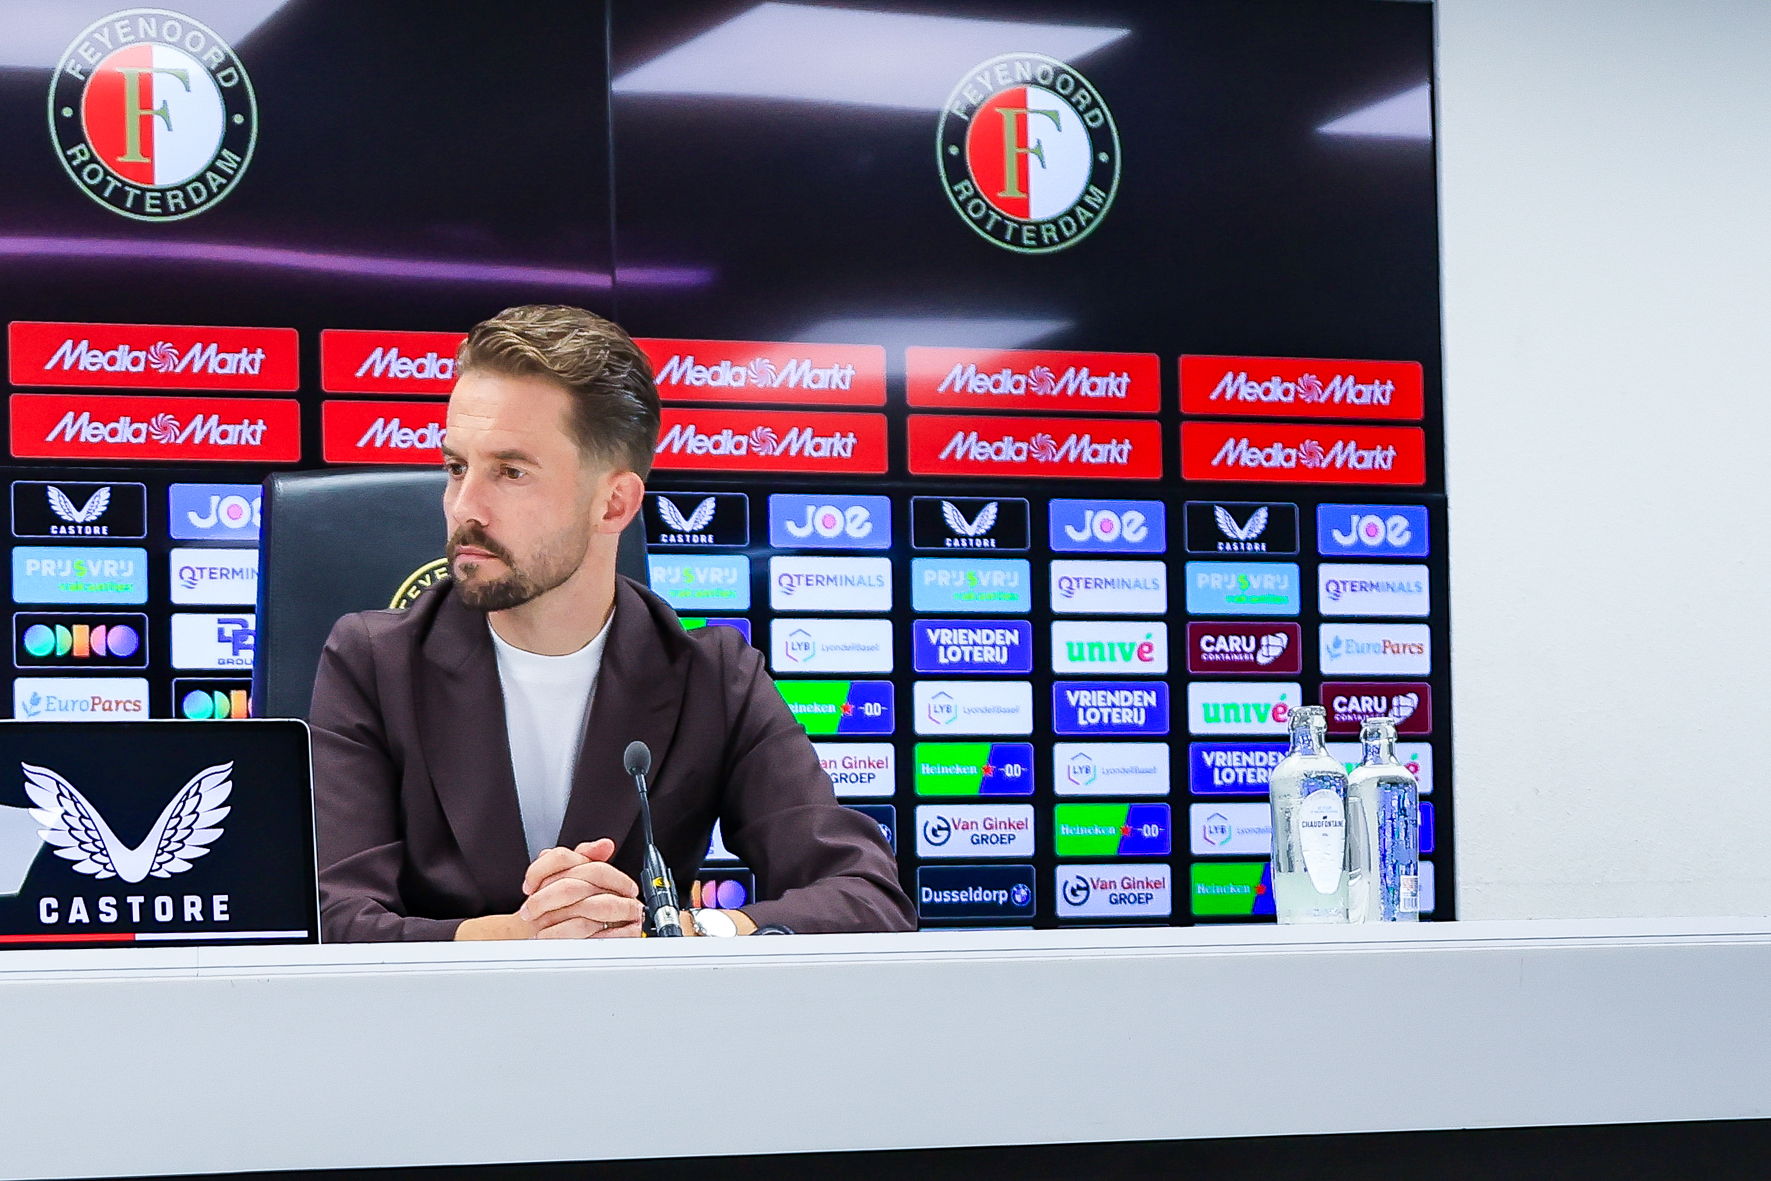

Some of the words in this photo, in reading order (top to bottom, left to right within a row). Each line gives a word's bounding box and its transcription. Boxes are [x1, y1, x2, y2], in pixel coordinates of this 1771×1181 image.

[66, 17, 239, 87] FEYENOORD
[952, 60, 1105, 129] FEYENOORD
[66, 143, 241, 214] ROTTERDAM
[953, 179, 1107, 246] ROTTERDAM
[45, 339, 148, 372] Media
[174, 342, 266, 375] Markt
[355, 347, 454, 379] Media
[654, 355, 746, 387] Media
[773, 358, 856, 390] Markt
[937, 363, 1026, 394] Media
[1052, 366, 1131, 398] Markt
[1209, 371, 1295, 402] Media
[1319, 374, 1395, 405] Markt
[45, 411, 148, 443] Media
[176, 414, 267, 445] Markt
[655, 425, 749, 456] Media
[773, 427, 858, 458] Markt
[939, 431, 1028, 461] Media
[1054, 434, 1133, 464] Markt
[1211, 438, 1297, 469] Media
[1321, 440, 1397, 470] Markt
[51, 525, 108, 535] CASTORE
[661, 533, 714, 544] CASTORE
[945, 538, 996, 548] CASTORE
[927, 629, 1019, 646] VRIENDEN
[1200, 634, 1255, 651] CARU
[791, 642, 810, 651] LYB
[1067, 633, 1155, 662] univé
[46, 696, 141, 713] EuroParcs
[1066, 690, 1156, 707] VRIENDEN
[1333, 695, 1386, 712] CARU
[934, 705, 951, 714] LYB
[819, 759, 837, 769] an
[842, 756, 889, 769] Ginkel
[921, 764, 977, 775] Heineken
[952, 819, 980, 831] Van
[984, 818, 1029, 831] Ginkel
[1061, 825, 1116, 835] Heineken
[970, 834, 1016, 845] GROEP
[1091, 877, 1115, 890] Van
[1119, 876, 1165, 890] Ginkel
[922, 888, 1008, 905] Dusseldorp
[1109, 894, 1154, 905] GROEP
[39, 895, 231, 924] CASTORE
